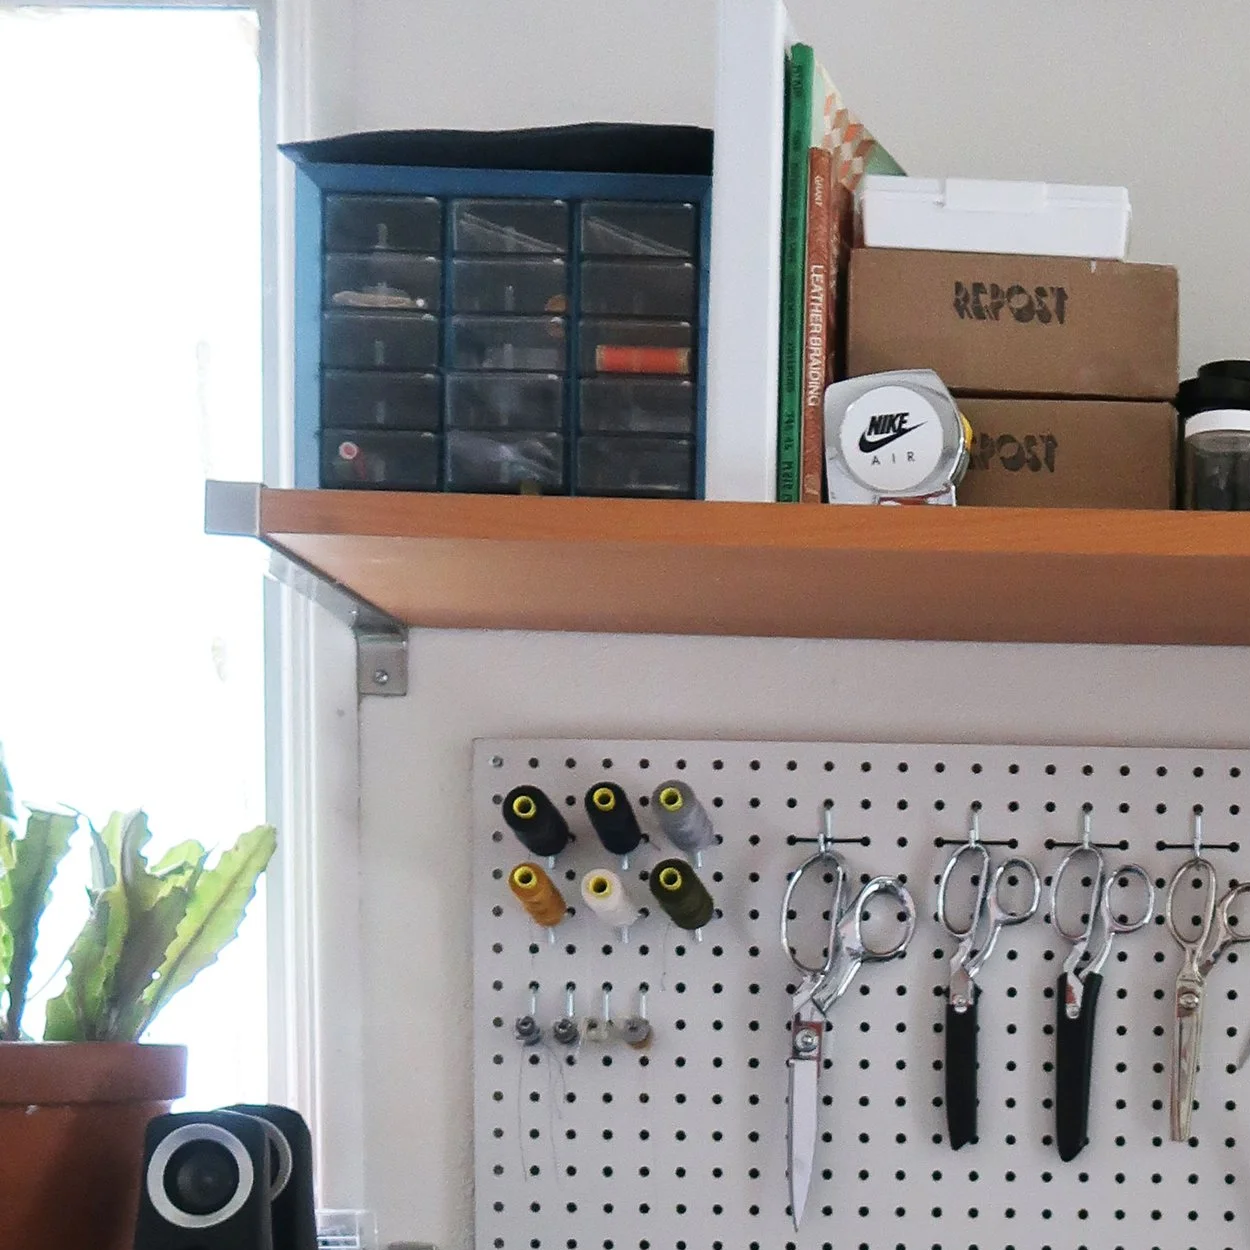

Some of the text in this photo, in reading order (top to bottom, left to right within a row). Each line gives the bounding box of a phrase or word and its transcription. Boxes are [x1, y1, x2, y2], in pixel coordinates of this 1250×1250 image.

[953, 281, 1068, 324] REPOST
[807, 264, 824, 406] LEATHER BRAIDING
[867, 412, 909, 436] NIKE
[871, 451, 915, 465] AIR
[968, 433, 1058, 472] POST
